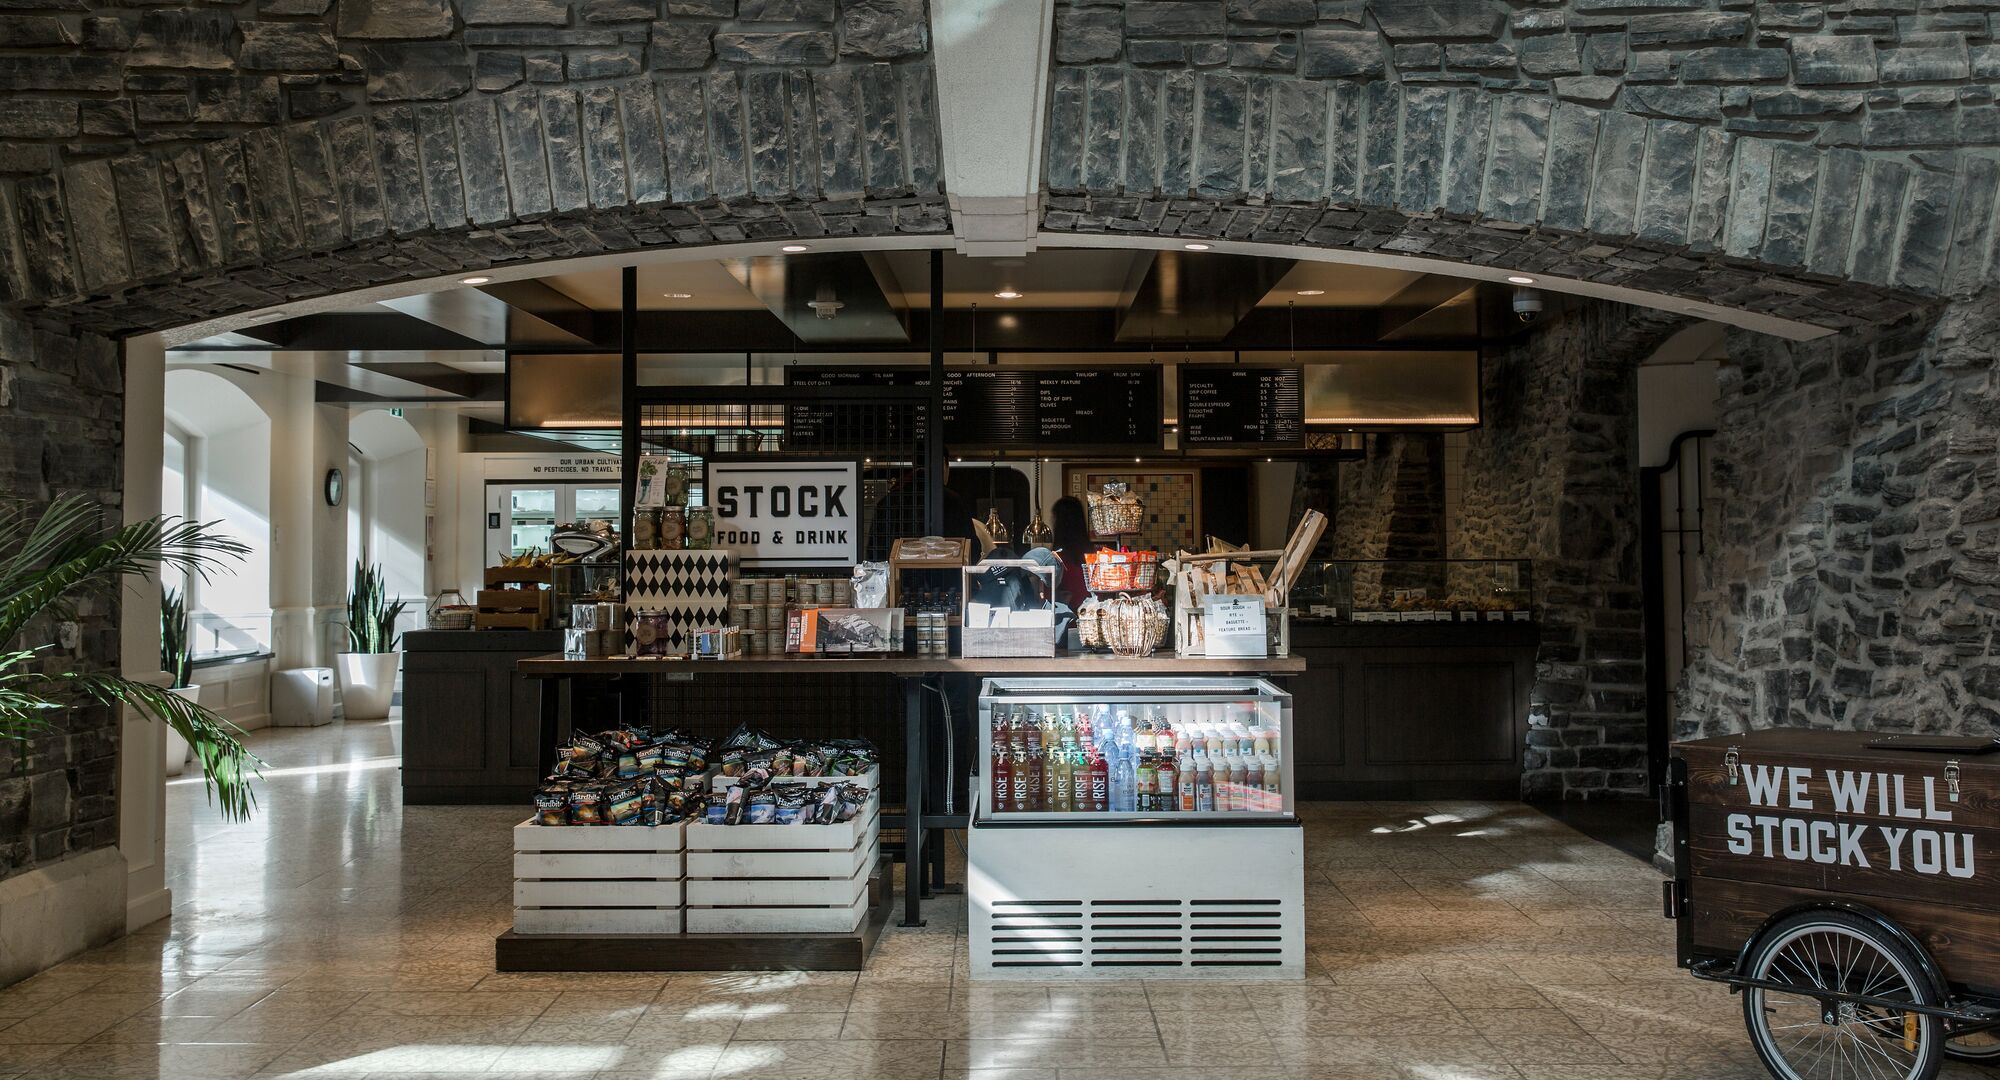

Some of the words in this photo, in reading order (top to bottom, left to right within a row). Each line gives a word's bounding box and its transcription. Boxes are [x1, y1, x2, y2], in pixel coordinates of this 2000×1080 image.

[717, 485, 848, 518] STOCK
[717, 530, 760, 544] FOOD
[772, 530, 784, 544] &
[796, 530, 848, 544] DRINK
[995, 776, 1007, 798] RISE
[1014, 776, 1026, 798] RISE
[1058, 776, 1070, 798] RISE
[1075, 776, 1088, 798] RISE
[1093, 776, 1105, 798] RISE
[1741, 764, 1813, 810] WE
[1826, 770, 1952, 821] WILL
[1727, 813, 1872, 868] STOCK
[1879, 826, 1974, 878] YOU
